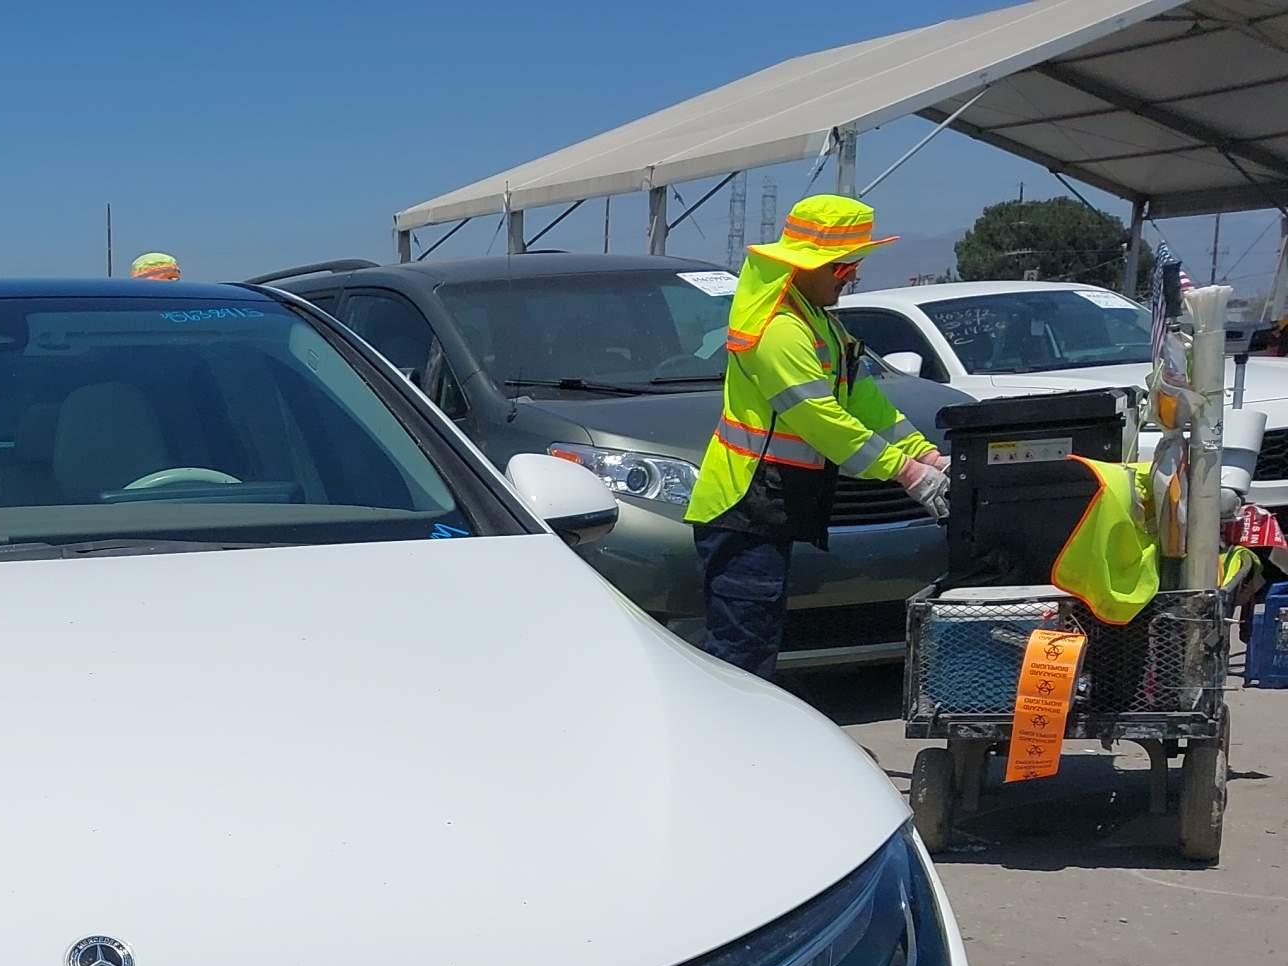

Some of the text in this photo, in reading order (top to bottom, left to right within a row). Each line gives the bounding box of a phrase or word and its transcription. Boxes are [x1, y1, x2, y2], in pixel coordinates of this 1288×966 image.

[1250, 534, 1260, 544] IN
[1030, 662, 1069, 672] BIOPELIGRO
[1029, 669, 1068, 679] BIOHAZARD
[1023, 697, 1063, 707] BIOPELIGRO
[1023, 704, 1061, 714] BIOHAZARD
